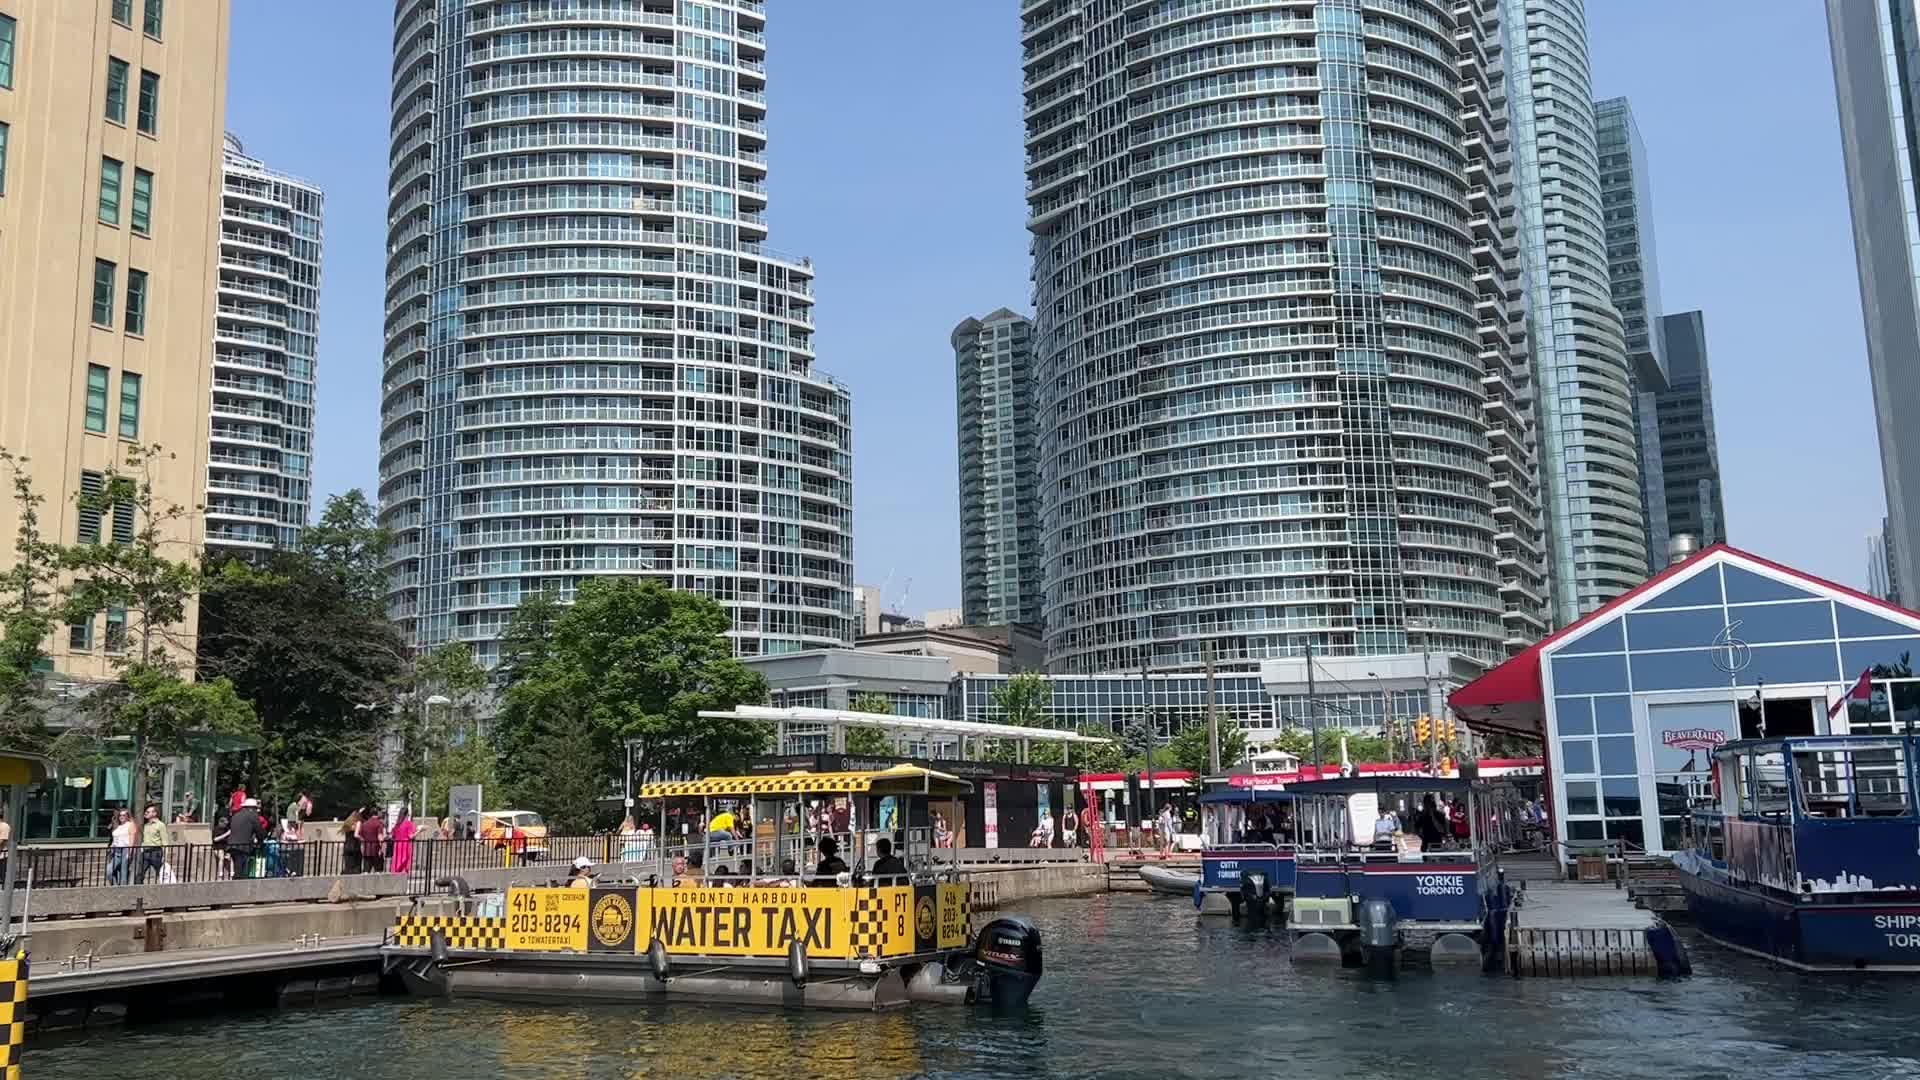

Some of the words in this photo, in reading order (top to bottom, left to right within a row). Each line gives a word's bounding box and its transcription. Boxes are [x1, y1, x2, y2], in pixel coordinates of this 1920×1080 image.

[1416, 876, 1464, 886] YORKIE
[673, 892, 734, 904] TORONTO
[742, 892, 808, 904] HARBOUR
[945, 891, 956, 905] 416
[1416, 886, 1465, 895] TORONTO
[513, 893, 537, 912] 416
[894, 893, 908, 913] PT
[511, 914, 581, 933] 203-8294
[651, 906, 751, 948] WATER
[761, 906, 832, 949] TAXI
[897, 915, 905, 937] 8
[942, 923, 960, 938] 8294
